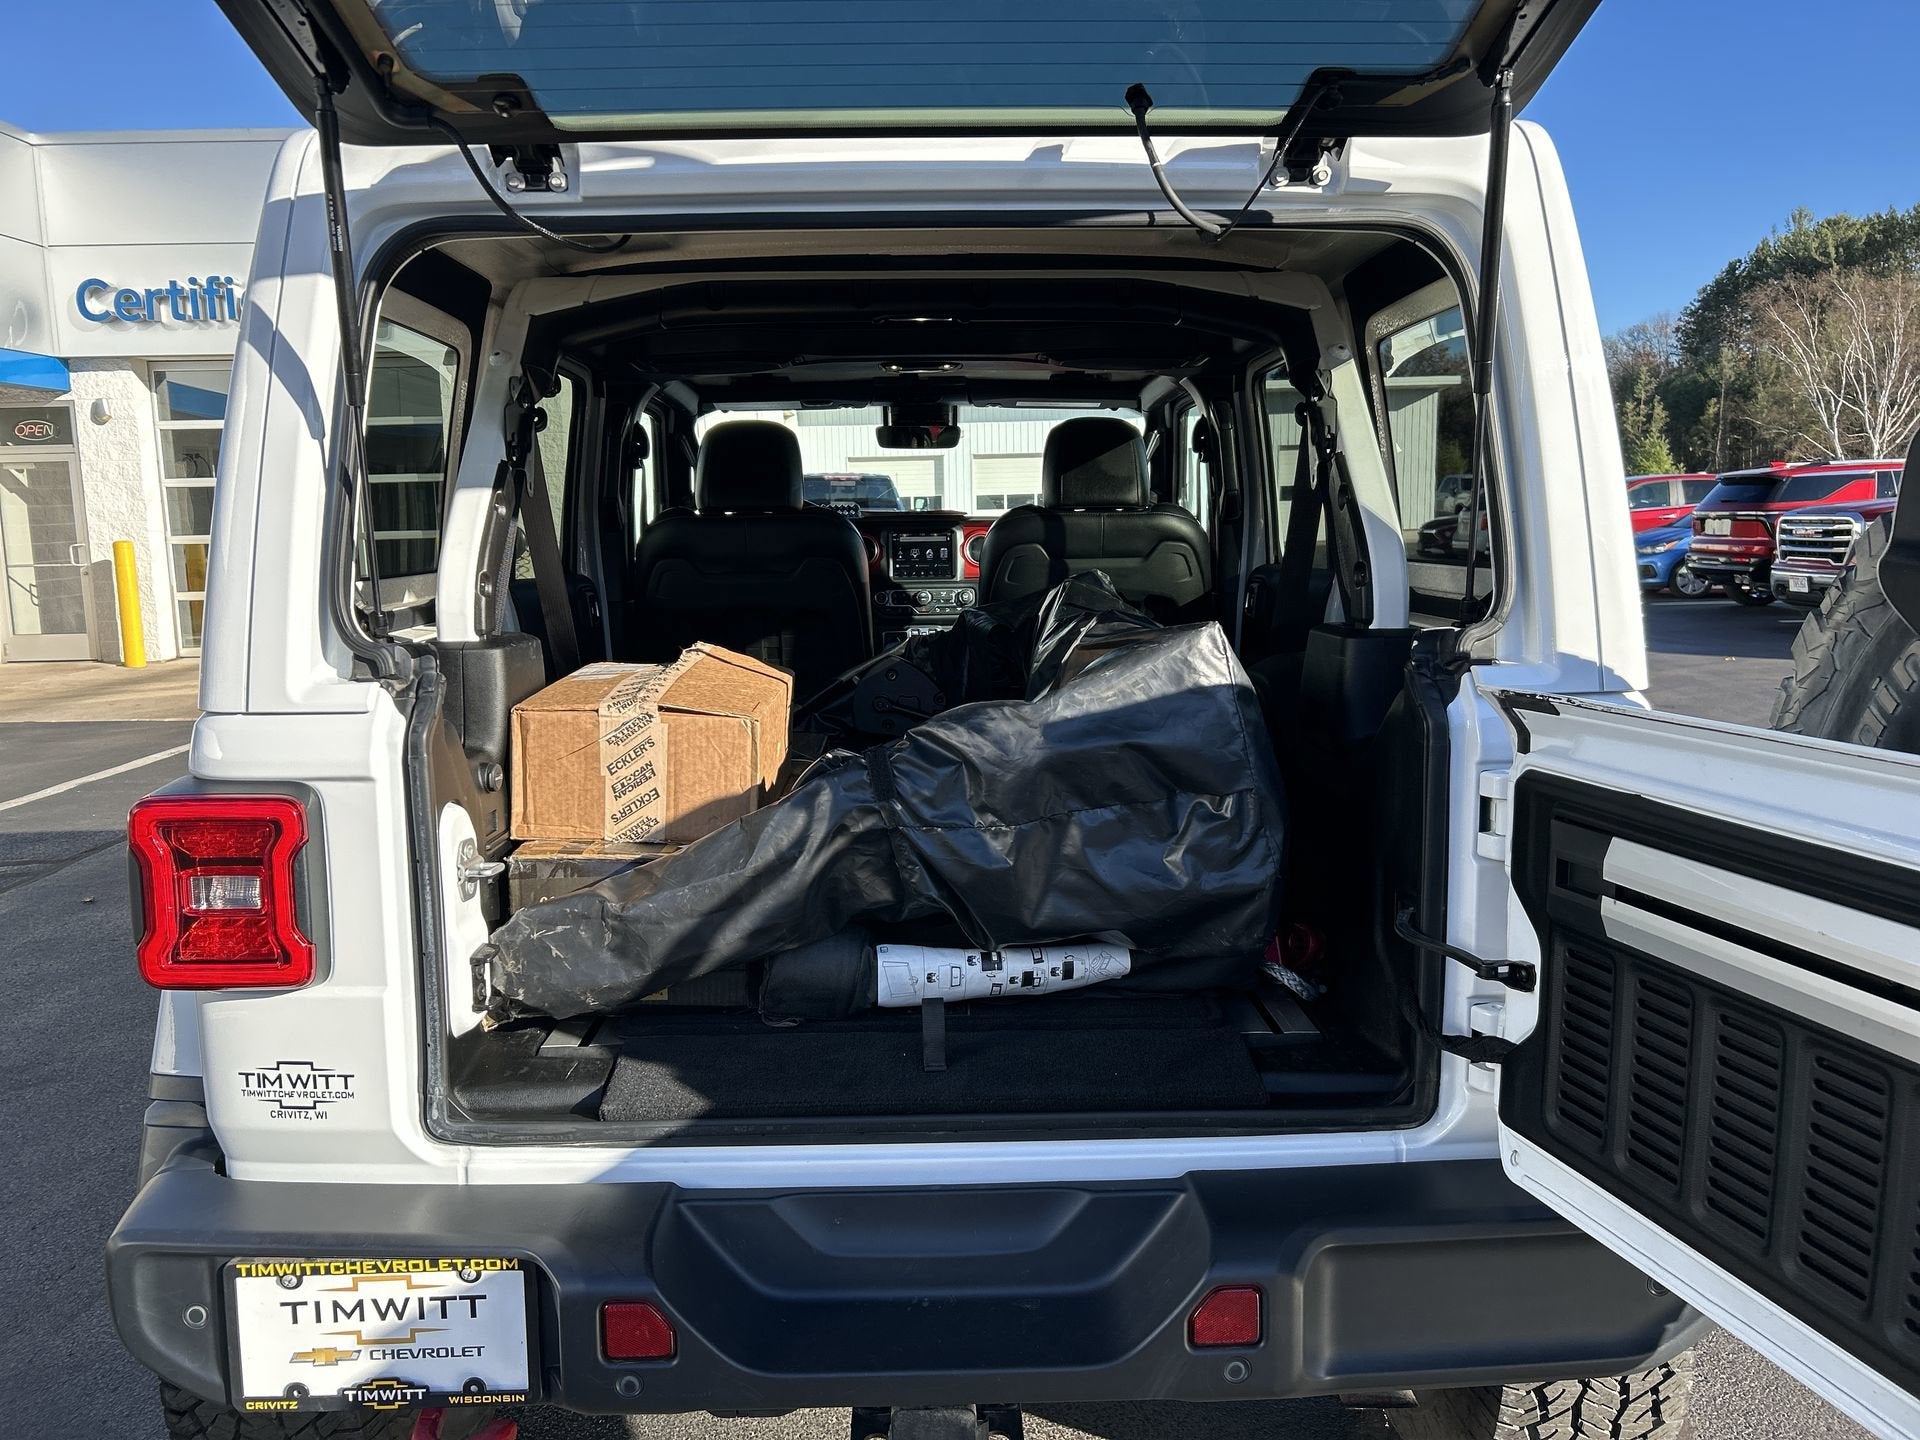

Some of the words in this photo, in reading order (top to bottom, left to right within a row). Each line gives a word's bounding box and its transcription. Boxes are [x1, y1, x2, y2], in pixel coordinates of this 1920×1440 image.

[75, 275, 238, 322] Certifi
[15, 425, 54, 436] OPEN
[613, 718, 653, 747] TERRAIN
[606, 738, 656, 776] ECKLER'S
[610, 787, 661, 823] ECKLER'S
[241, 1089, 355, 1099] TIMWITTCHEVROLET.COM
[270, 1110, 312, 1120] CRIVITZ,
[315, 1110, 328, 1119] WI
[236, 1258, 519, 1277] TIMWITTCHEVROLET.COM
[279, 1294, 487, 1324] TIMWITT
[369, 1346, 485, 1361] CHEVROLET
[246, 1400, 298, 1410] CRIVITZ
[448, 1394, 525, 1404] WISCONSIN
[344, 1388, 427, 1402] TIMWITT
